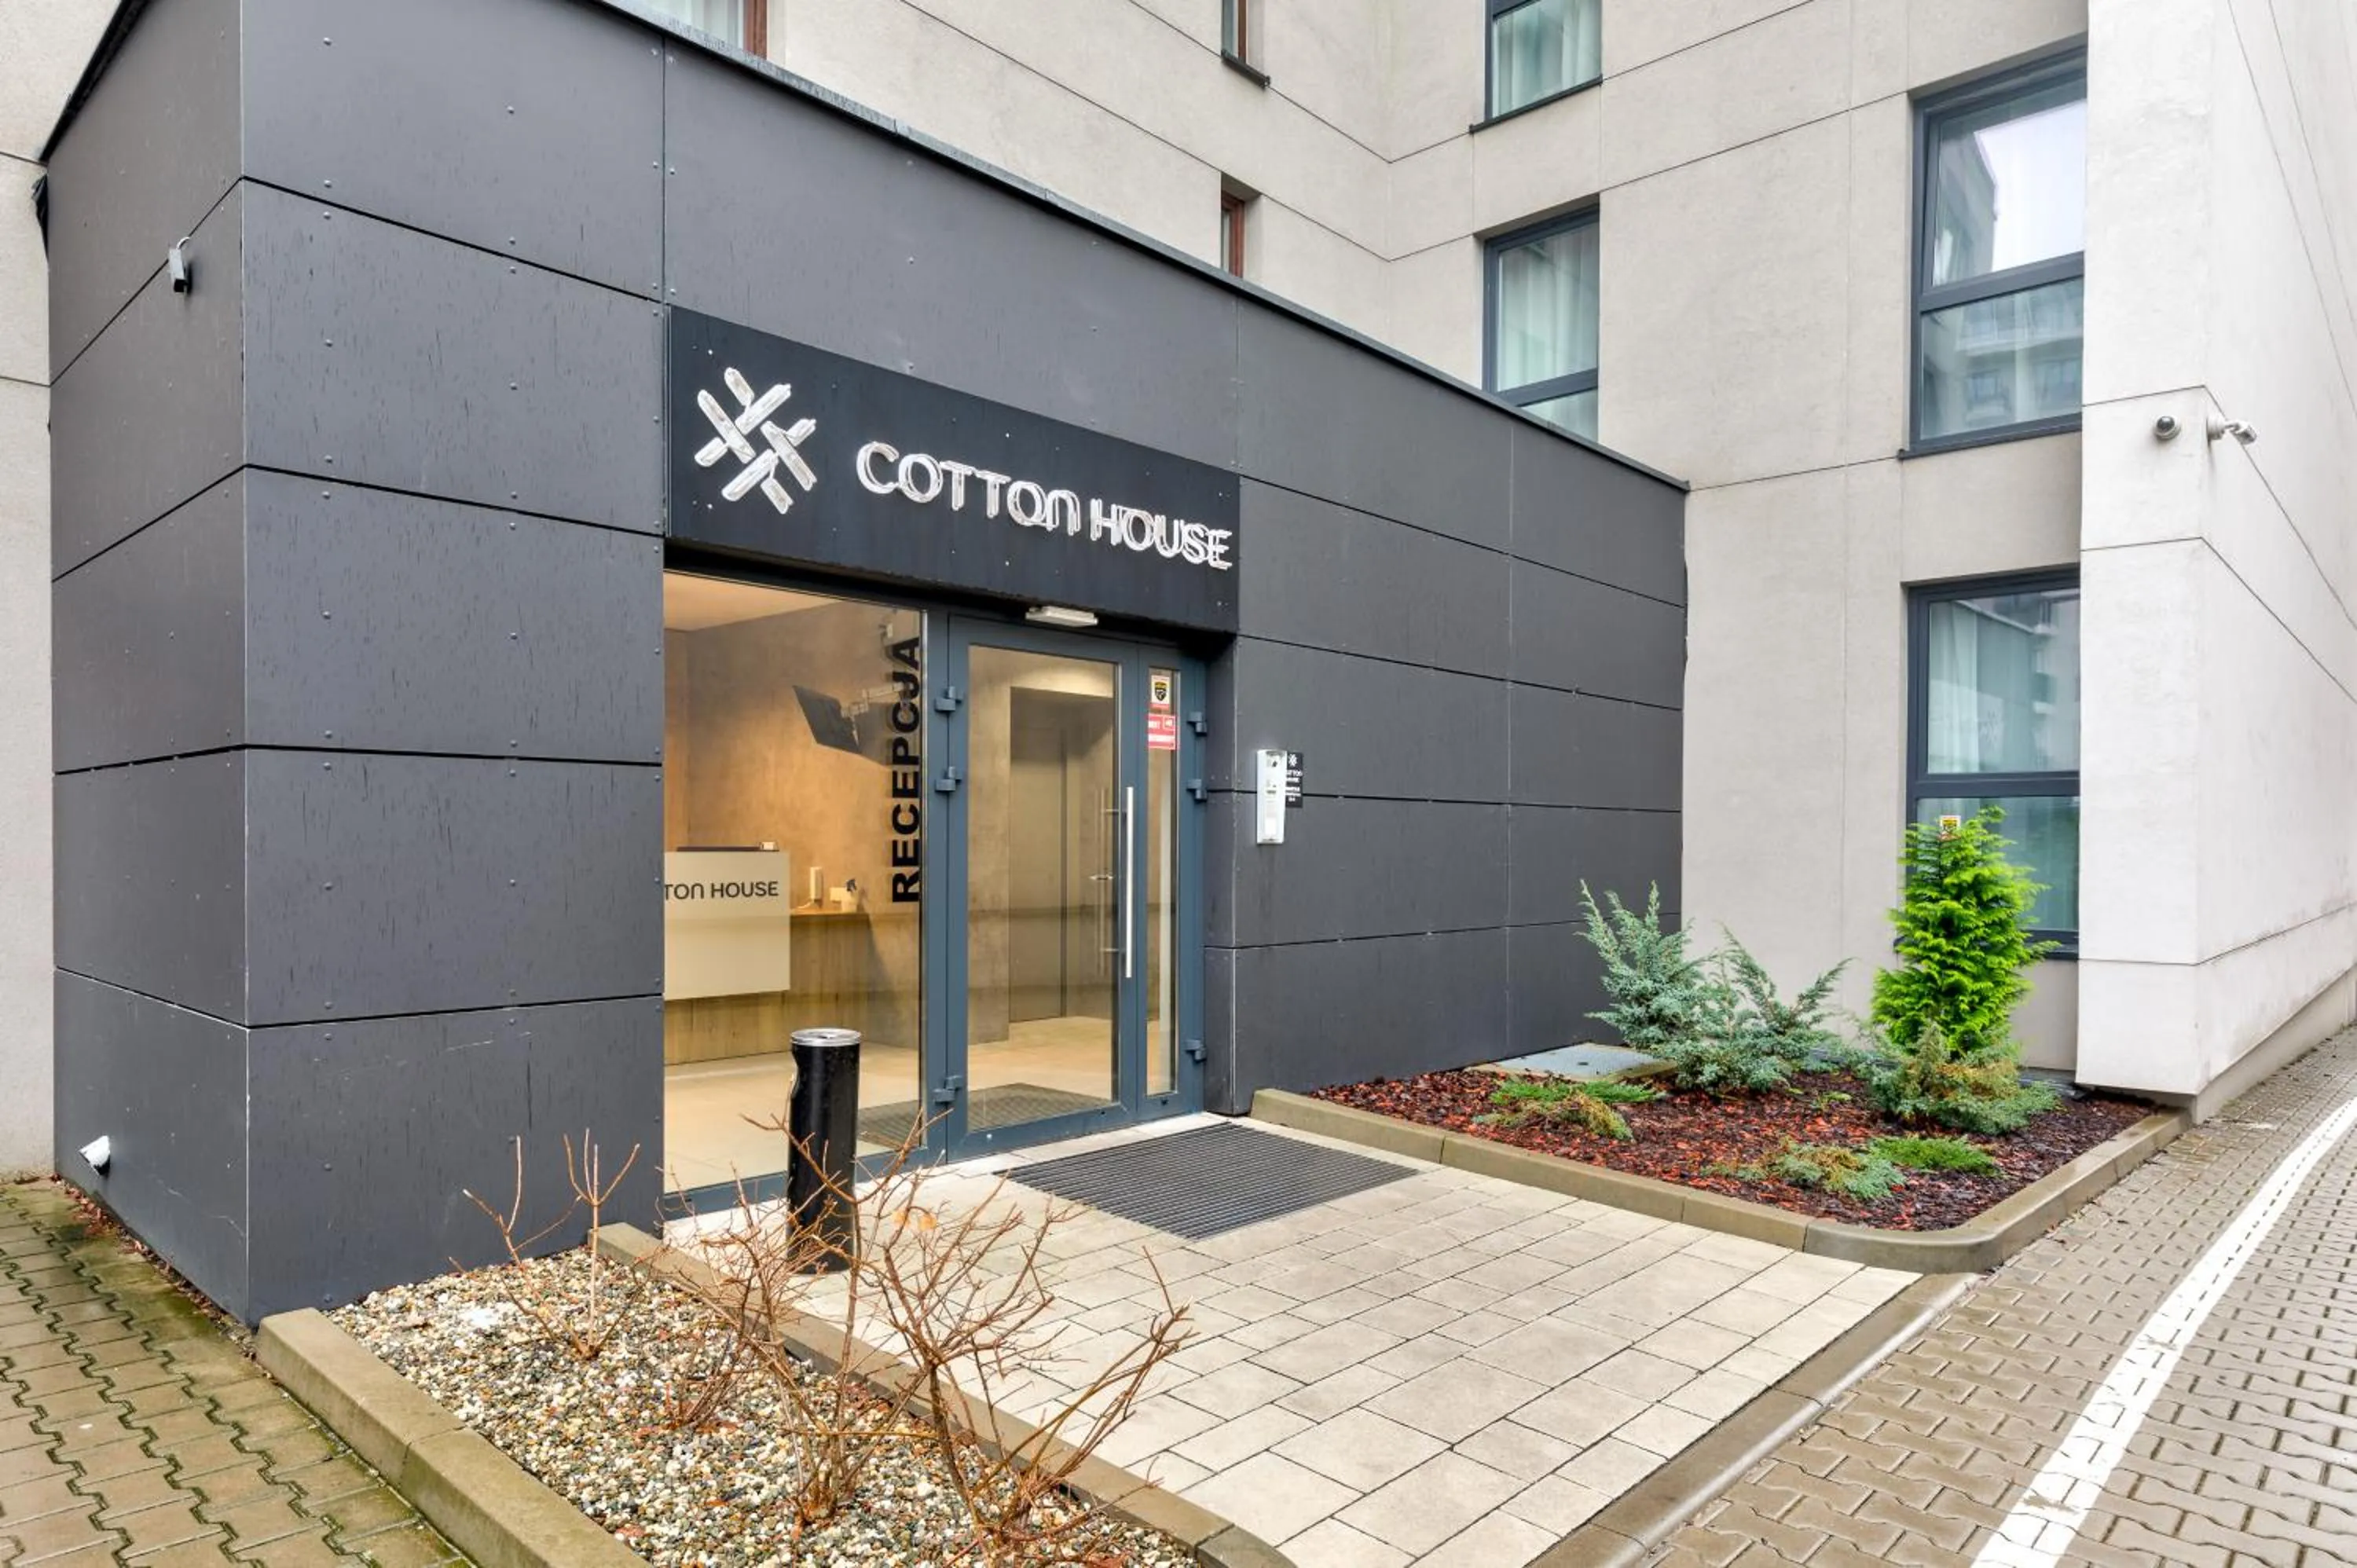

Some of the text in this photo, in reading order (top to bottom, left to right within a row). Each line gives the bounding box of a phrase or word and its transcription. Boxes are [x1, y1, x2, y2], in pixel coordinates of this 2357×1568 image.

[1090, 499, 1233, 570] HOUSE
[892, 636, 920, 903] RECEPCJA
[710, 881, 779, 899] HOUSE
